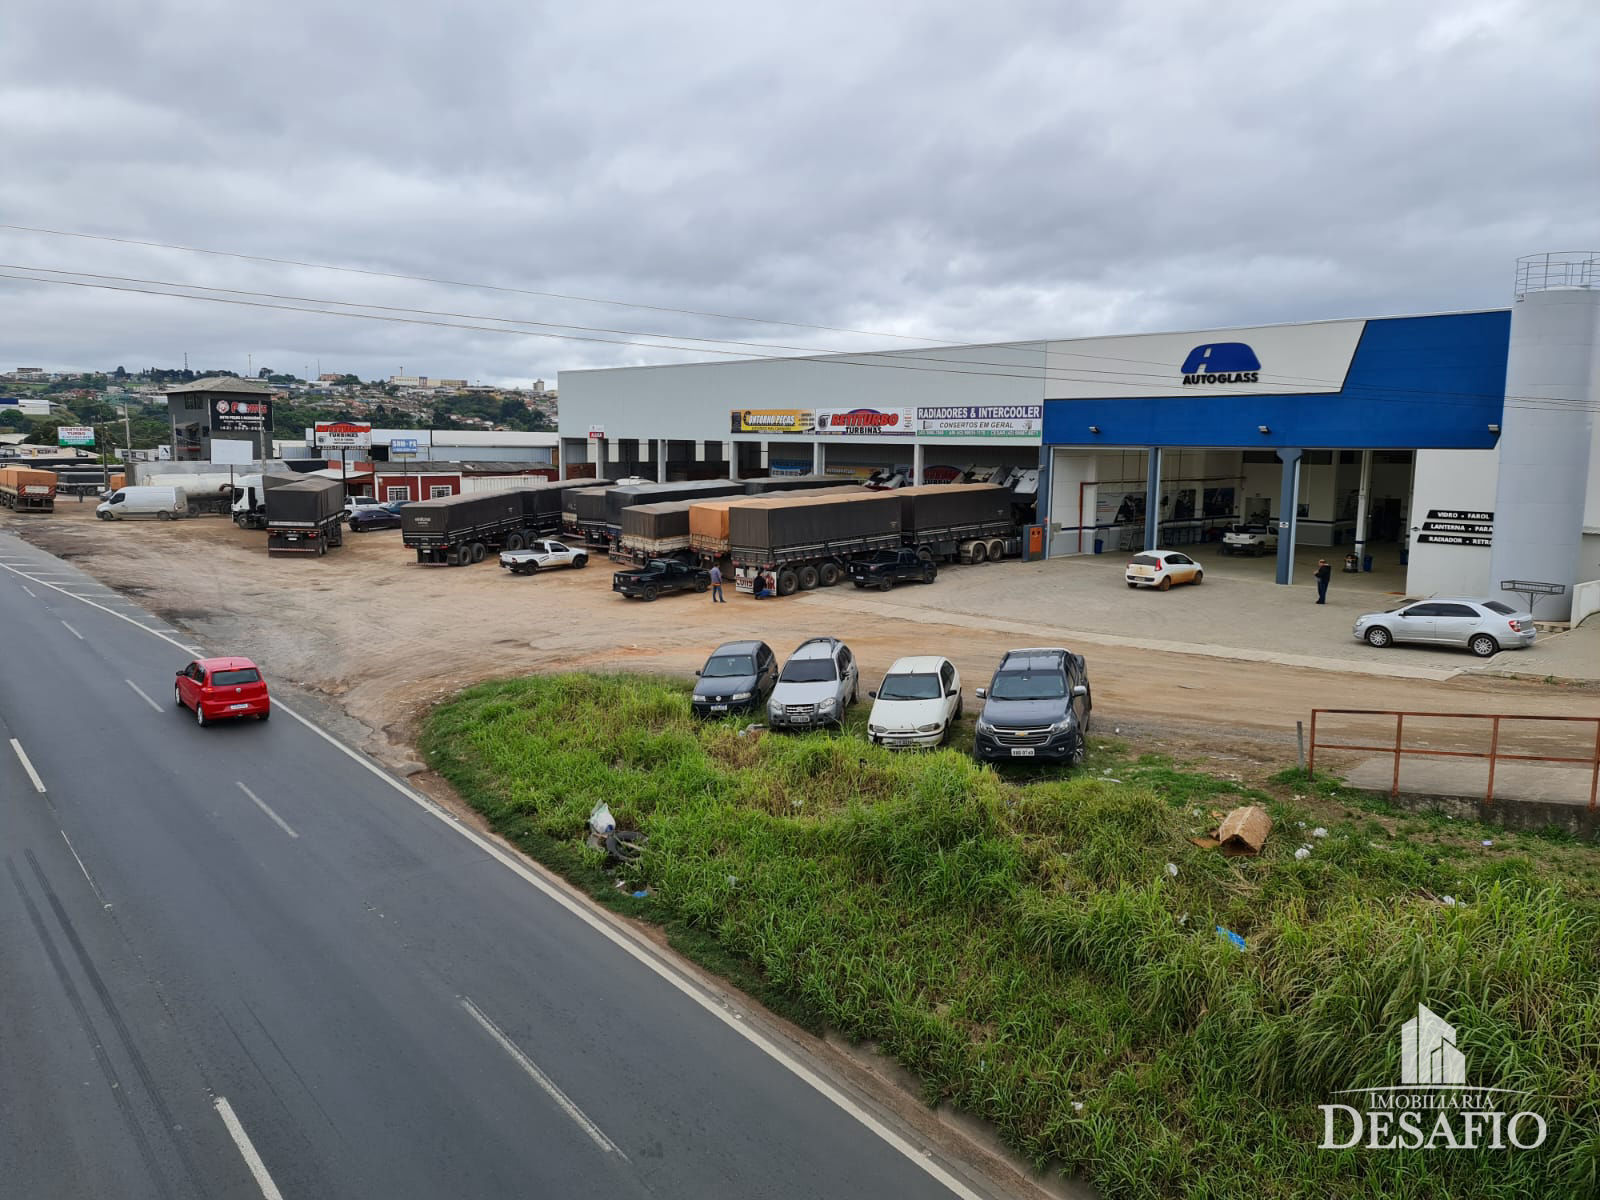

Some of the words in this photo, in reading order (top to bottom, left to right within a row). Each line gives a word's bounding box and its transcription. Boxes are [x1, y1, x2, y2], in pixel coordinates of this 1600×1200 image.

[1182, 372, 1258, 385] AUTOGLASS
[918, 408, 968, 419] RADIADORES
[970, 407, 976, 418] &
[978, 406, 1040, 418] INTERCOOLER
[831, 413, 899, 426] RETITURBO
[939, 421, 978, 429] CONSERTOS
[979, 421, 989, 429] EM
[990, 421, 1014, 429] GERAL
[845, 426, 882, 434] TURBINAS
